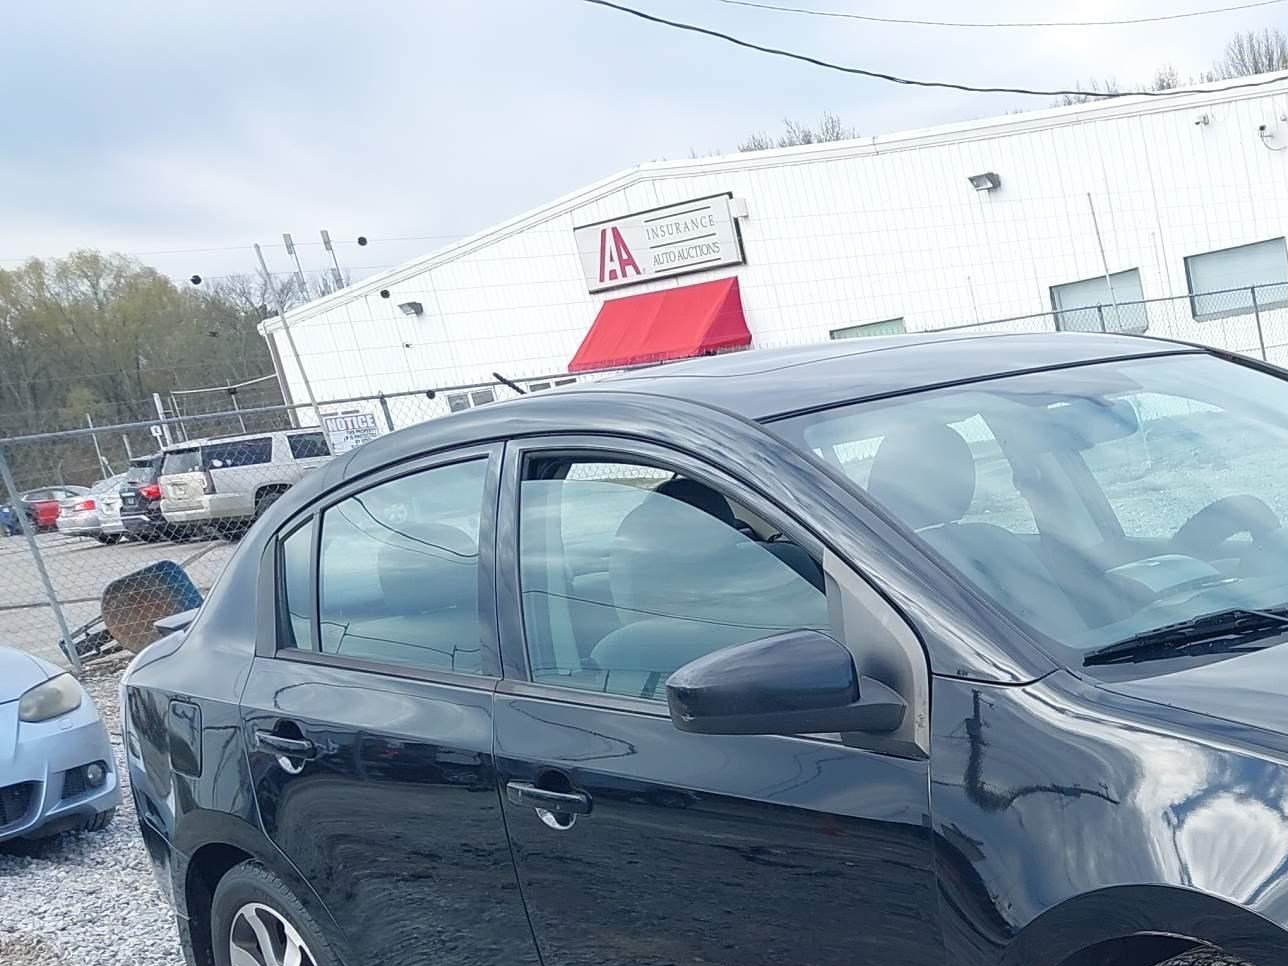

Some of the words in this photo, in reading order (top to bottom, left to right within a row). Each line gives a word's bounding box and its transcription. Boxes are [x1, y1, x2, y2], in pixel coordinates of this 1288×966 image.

[646, 215, 715, 240] INSURANCE
[653, 250, 677, 266] AUTO
[677, 241, 720, 261] AUCTIONS
[326, 415, 375, 431] NOTICE
